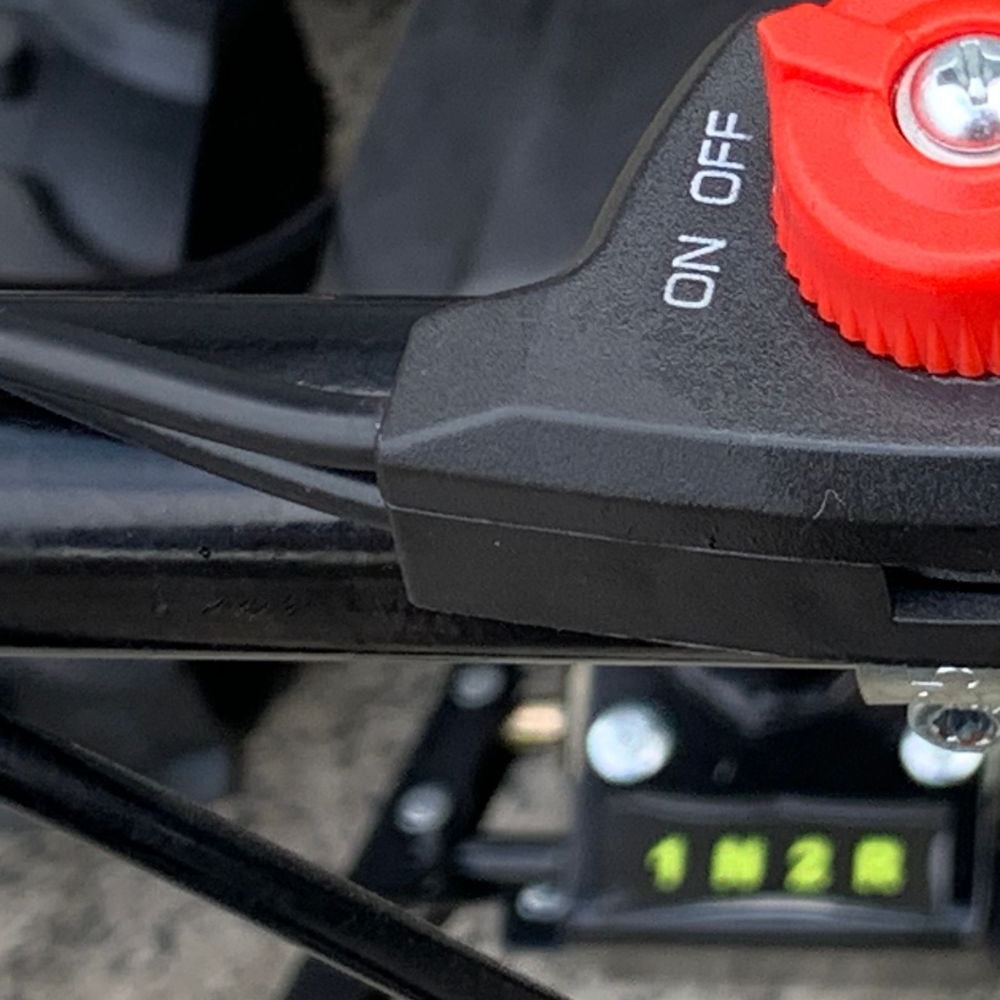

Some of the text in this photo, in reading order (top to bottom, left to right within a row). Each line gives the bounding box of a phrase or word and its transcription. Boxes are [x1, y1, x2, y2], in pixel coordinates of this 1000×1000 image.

[663, 109, 753, 309] ON OFF
[645, 833, 689, 893] 1
[784, 833, 834, 892] 2
